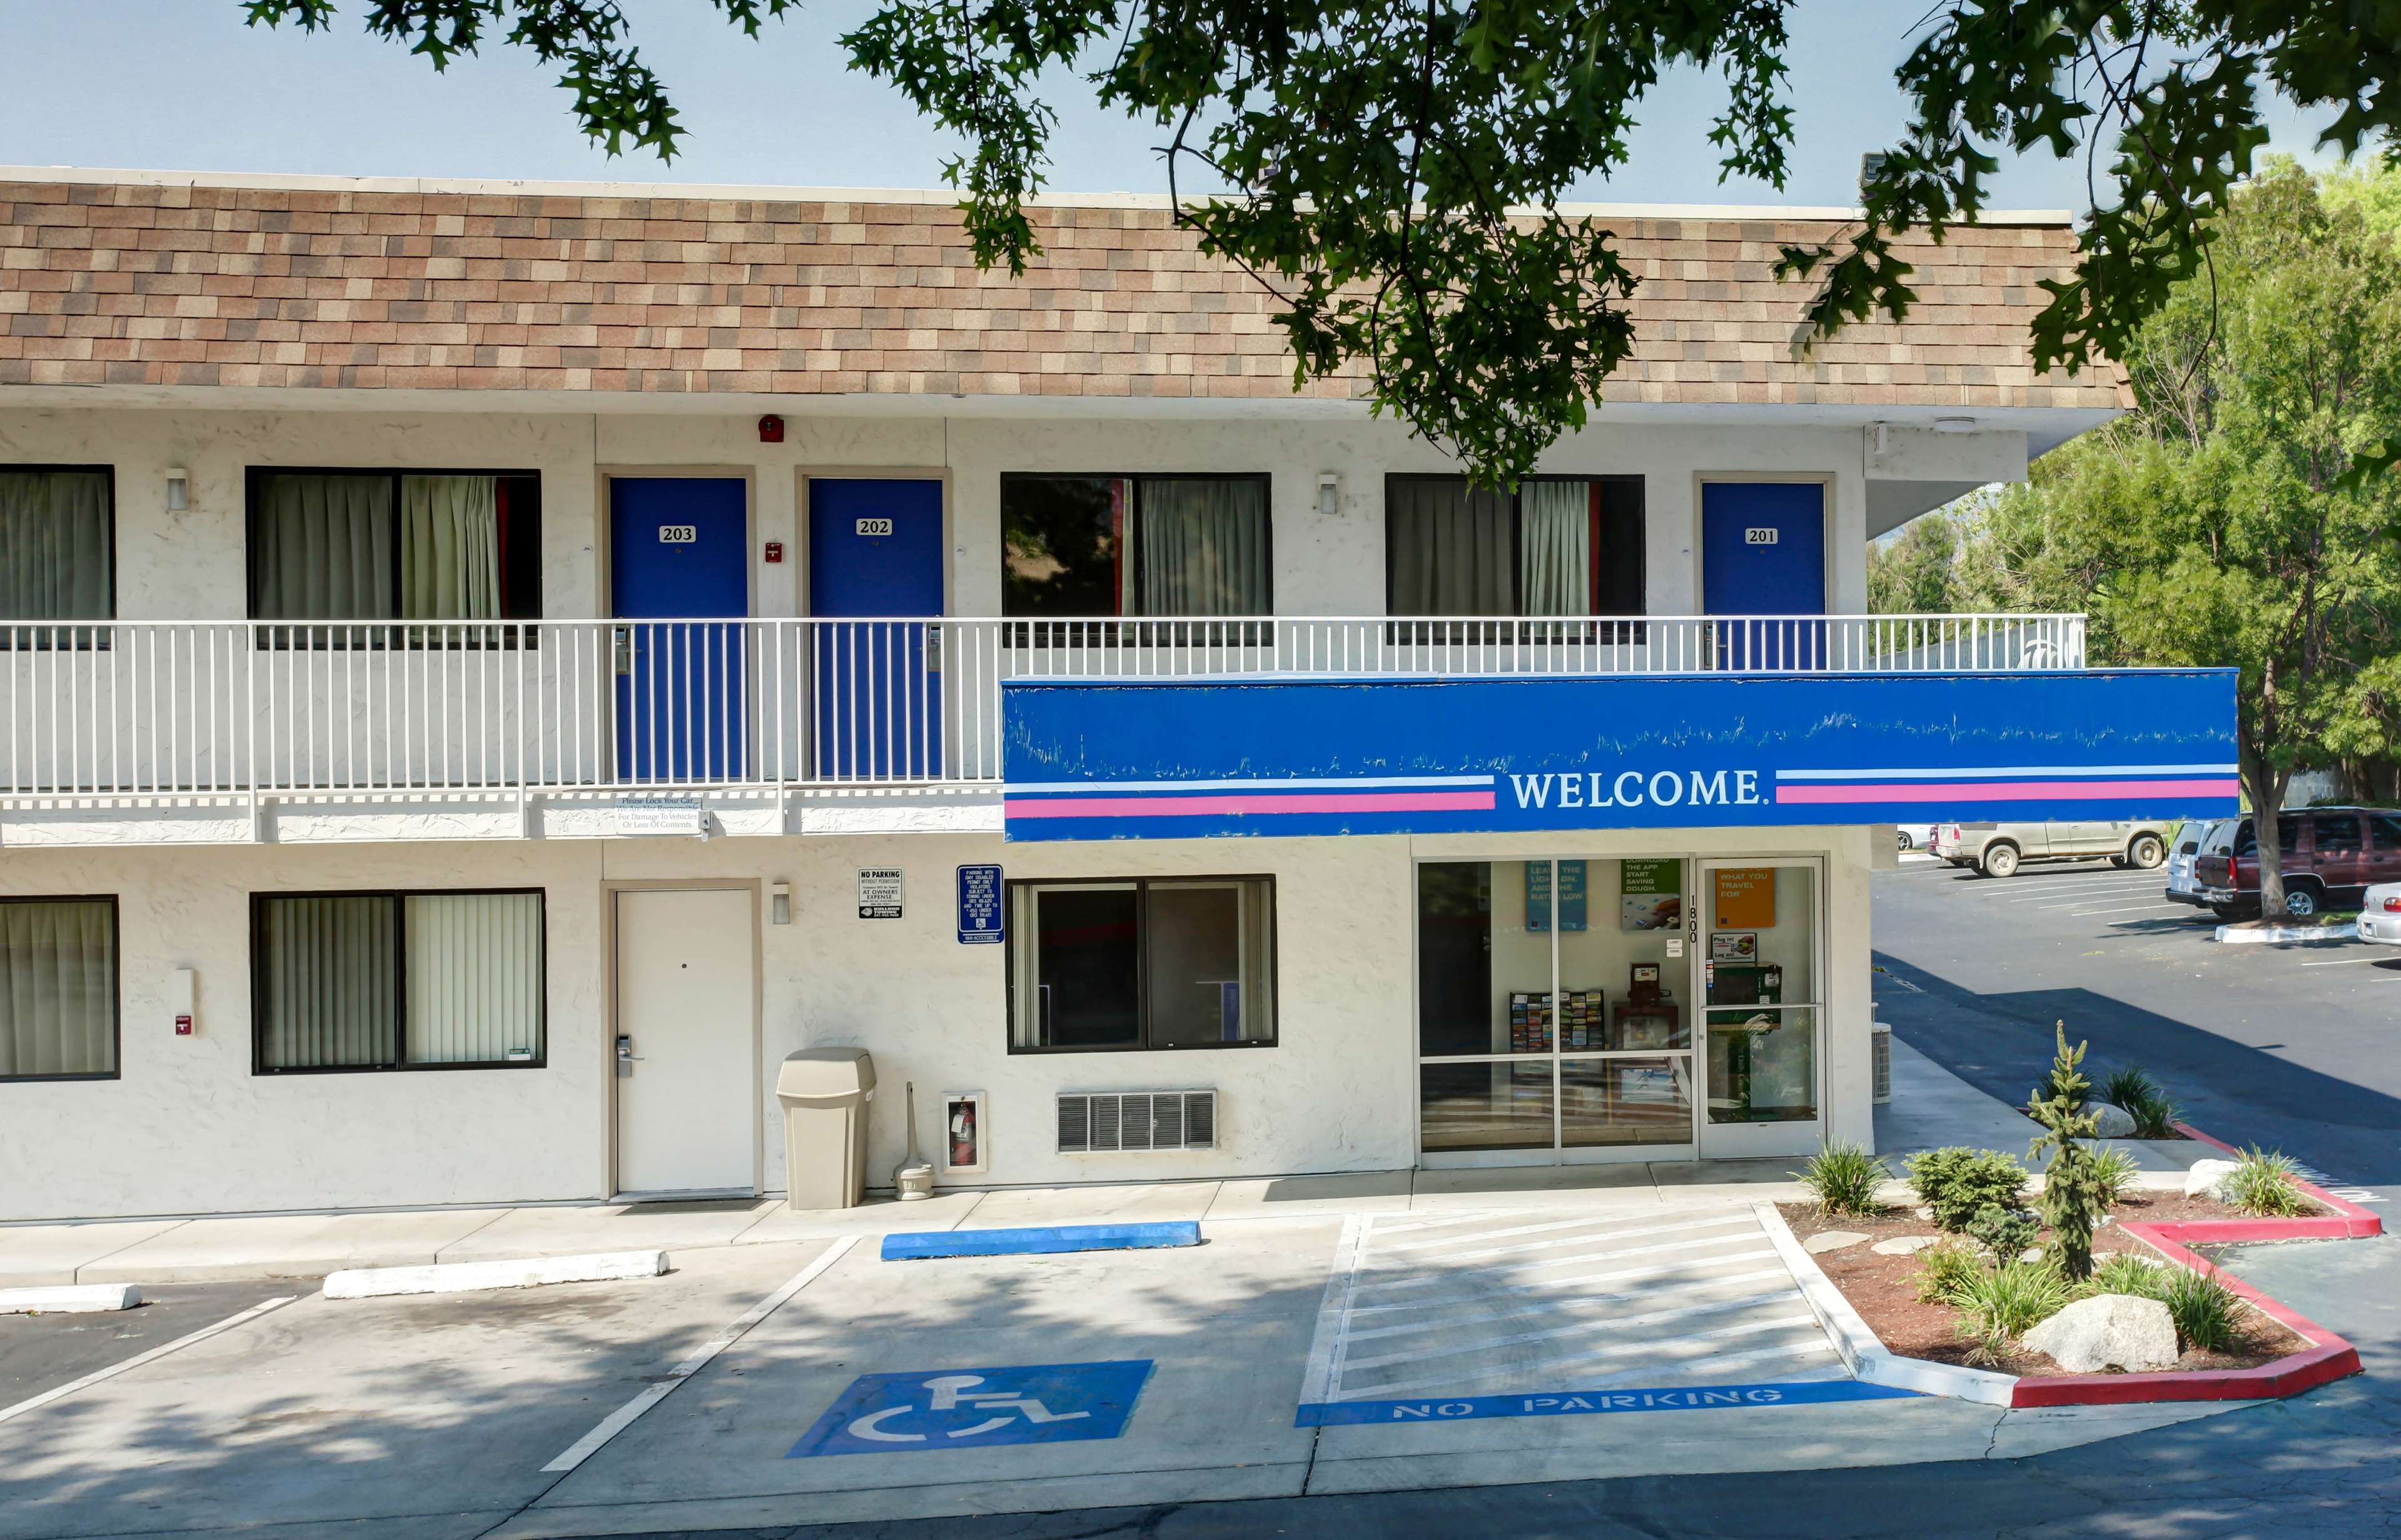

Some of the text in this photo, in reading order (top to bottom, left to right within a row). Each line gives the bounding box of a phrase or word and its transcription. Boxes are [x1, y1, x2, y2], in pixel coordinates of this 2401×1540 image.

[860, 521, 888, 533] 202
[664, 528, 692, 540] 203
[1749, 530, 1773, 541] 201
[632, 813, 660, 822] Damage
[1393, 1389, 1782, 1418] NO PARKING
